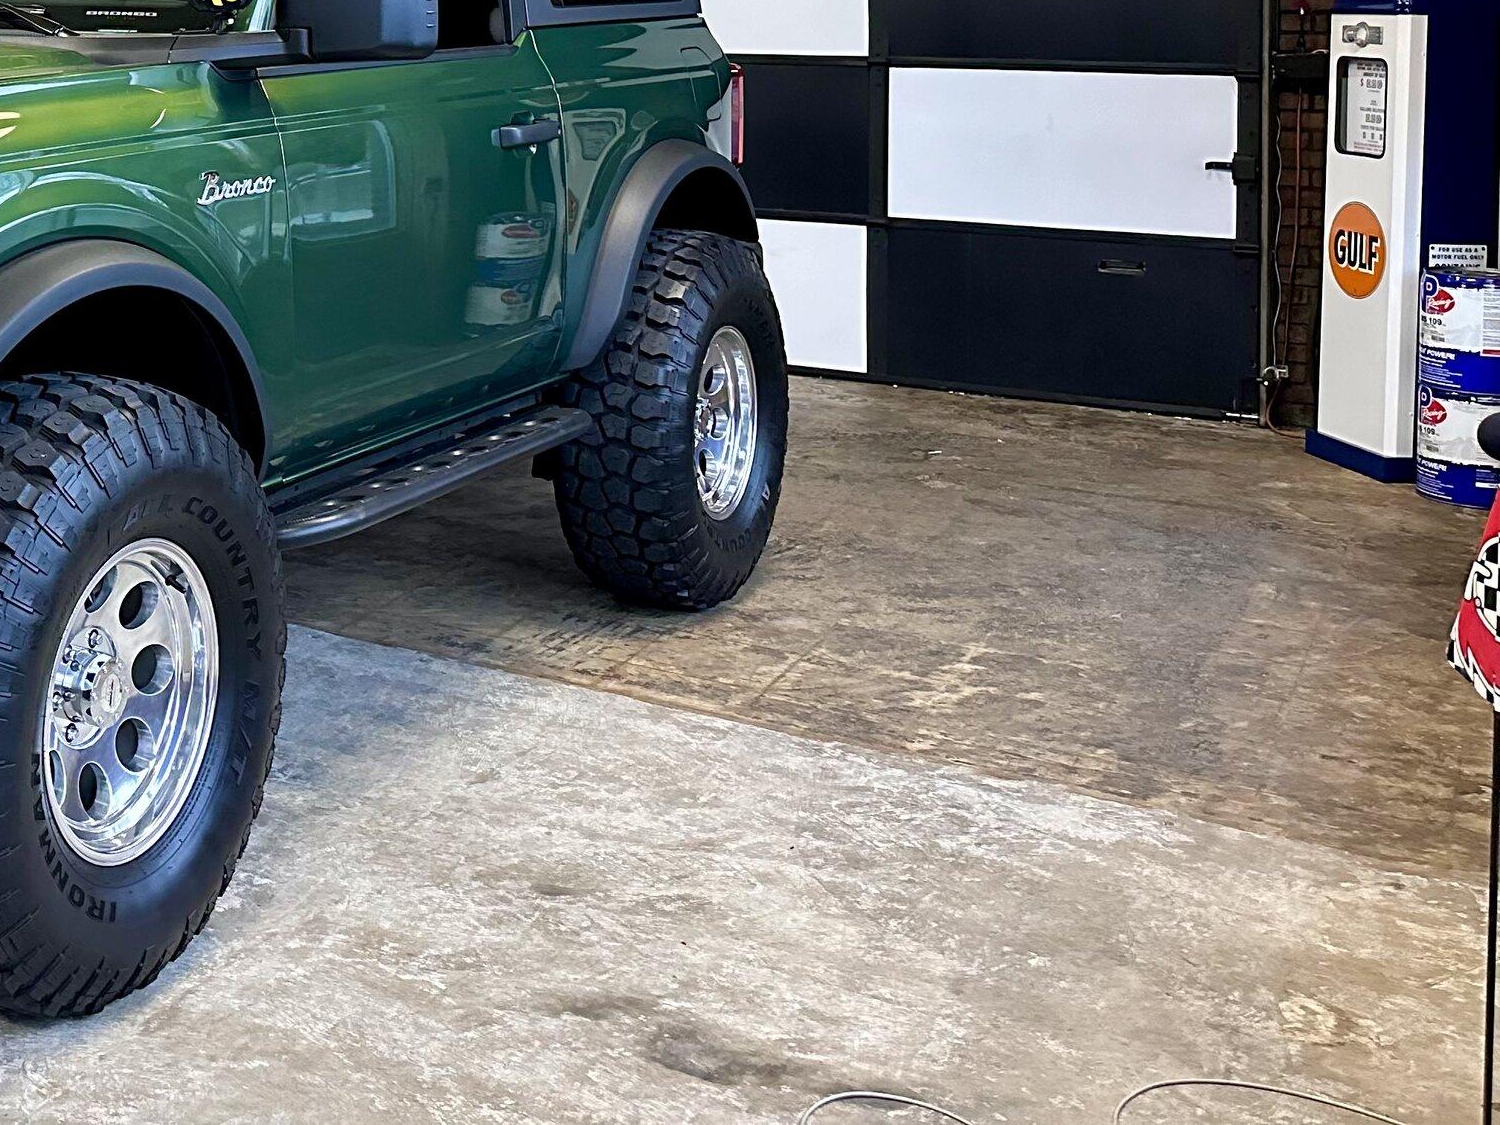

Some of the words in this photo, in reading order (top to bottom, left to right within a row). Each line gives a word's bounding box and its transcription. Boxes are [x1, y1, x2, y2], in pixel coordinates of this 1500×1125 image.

[196, 169, 277, 206] Bronco
[1334, 229, 1381, 275] GULF
[1428, 297, 1455, 312] Racing
[1429, 317, 1443, 326] 109
[1422, 408, 1447, 421] Racing
[1423, 426, 1436, 436] 109
[181, 495, 264, 661] COUNTRY
[30, 752, 117, 924] IRONMAN
